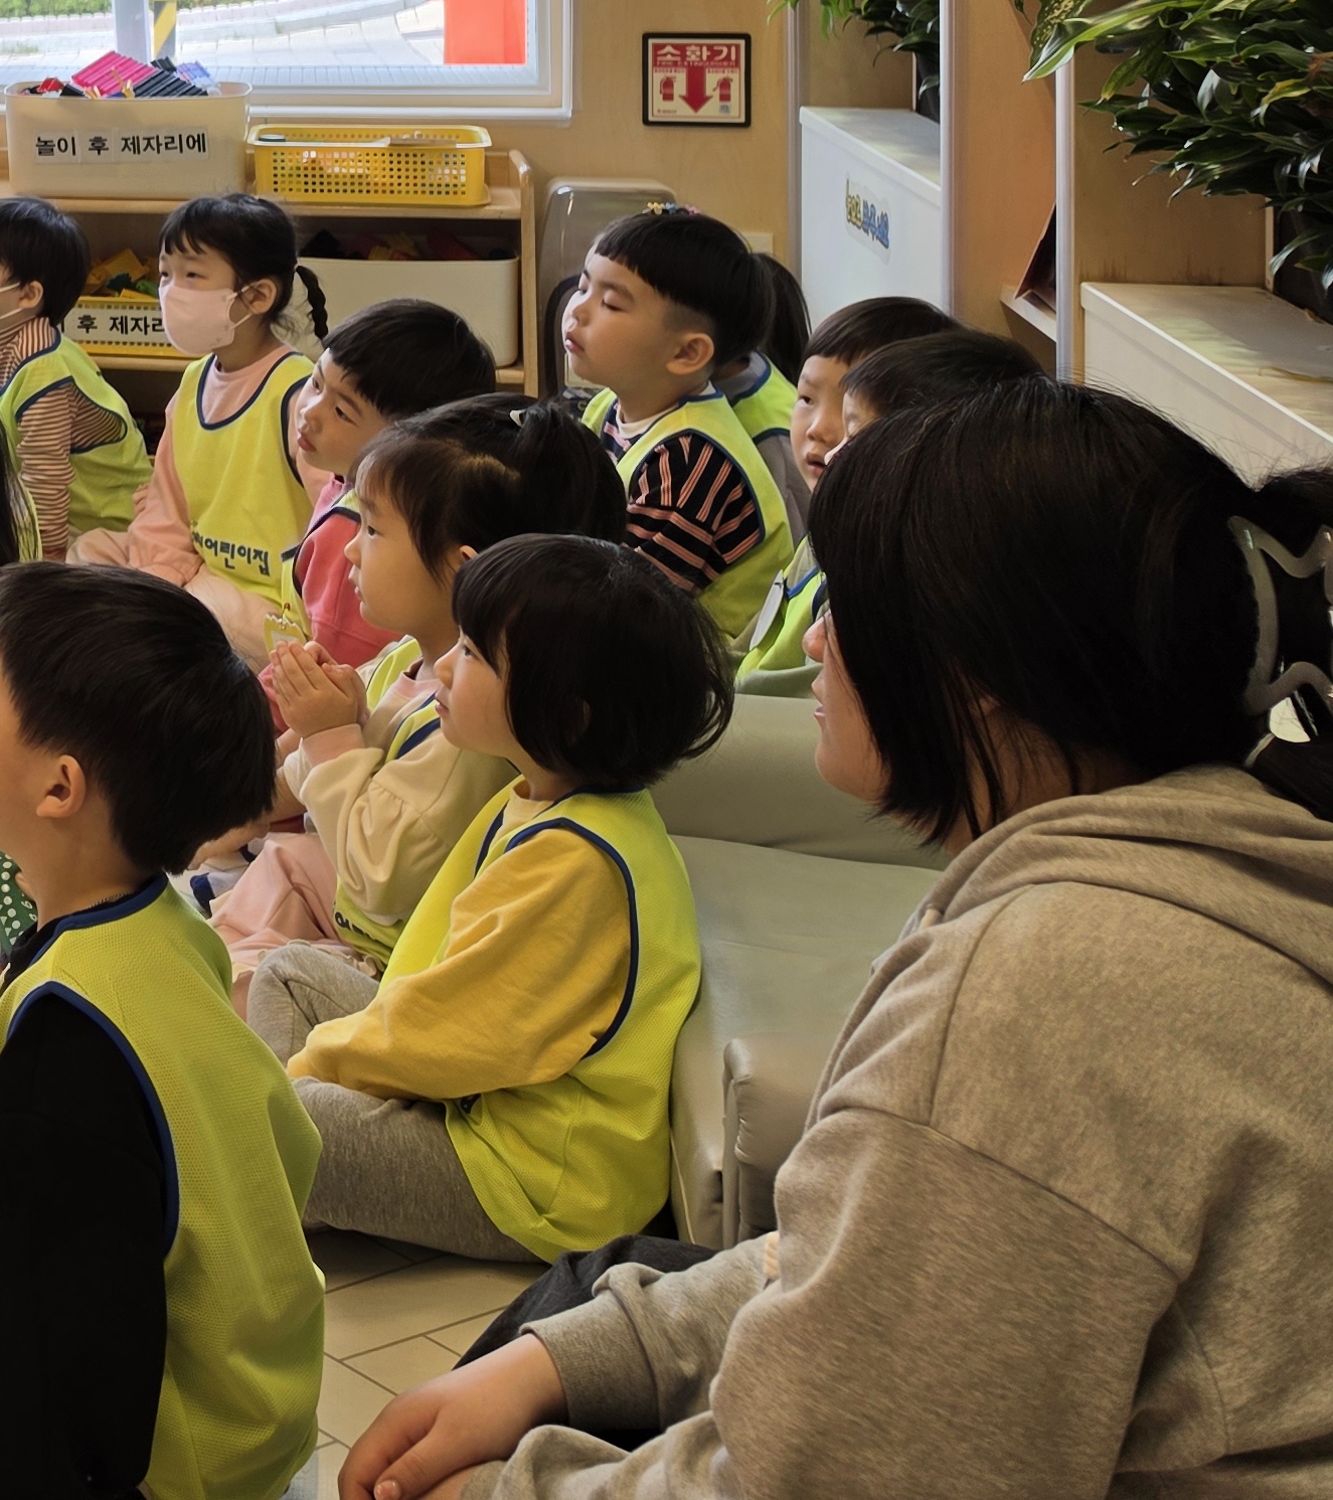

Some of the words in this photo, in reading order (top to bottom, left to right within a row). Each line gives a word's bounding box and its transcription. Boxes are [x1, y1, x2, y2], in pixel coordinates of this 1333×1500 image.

[657, 45, 736, 62] 소화기
[35, 136, 76, 156] 놀이
[88, 136, 109, 156] 후
[121, 133, 207, 156] 제자리에
[77, 315, 98, 334] 후
